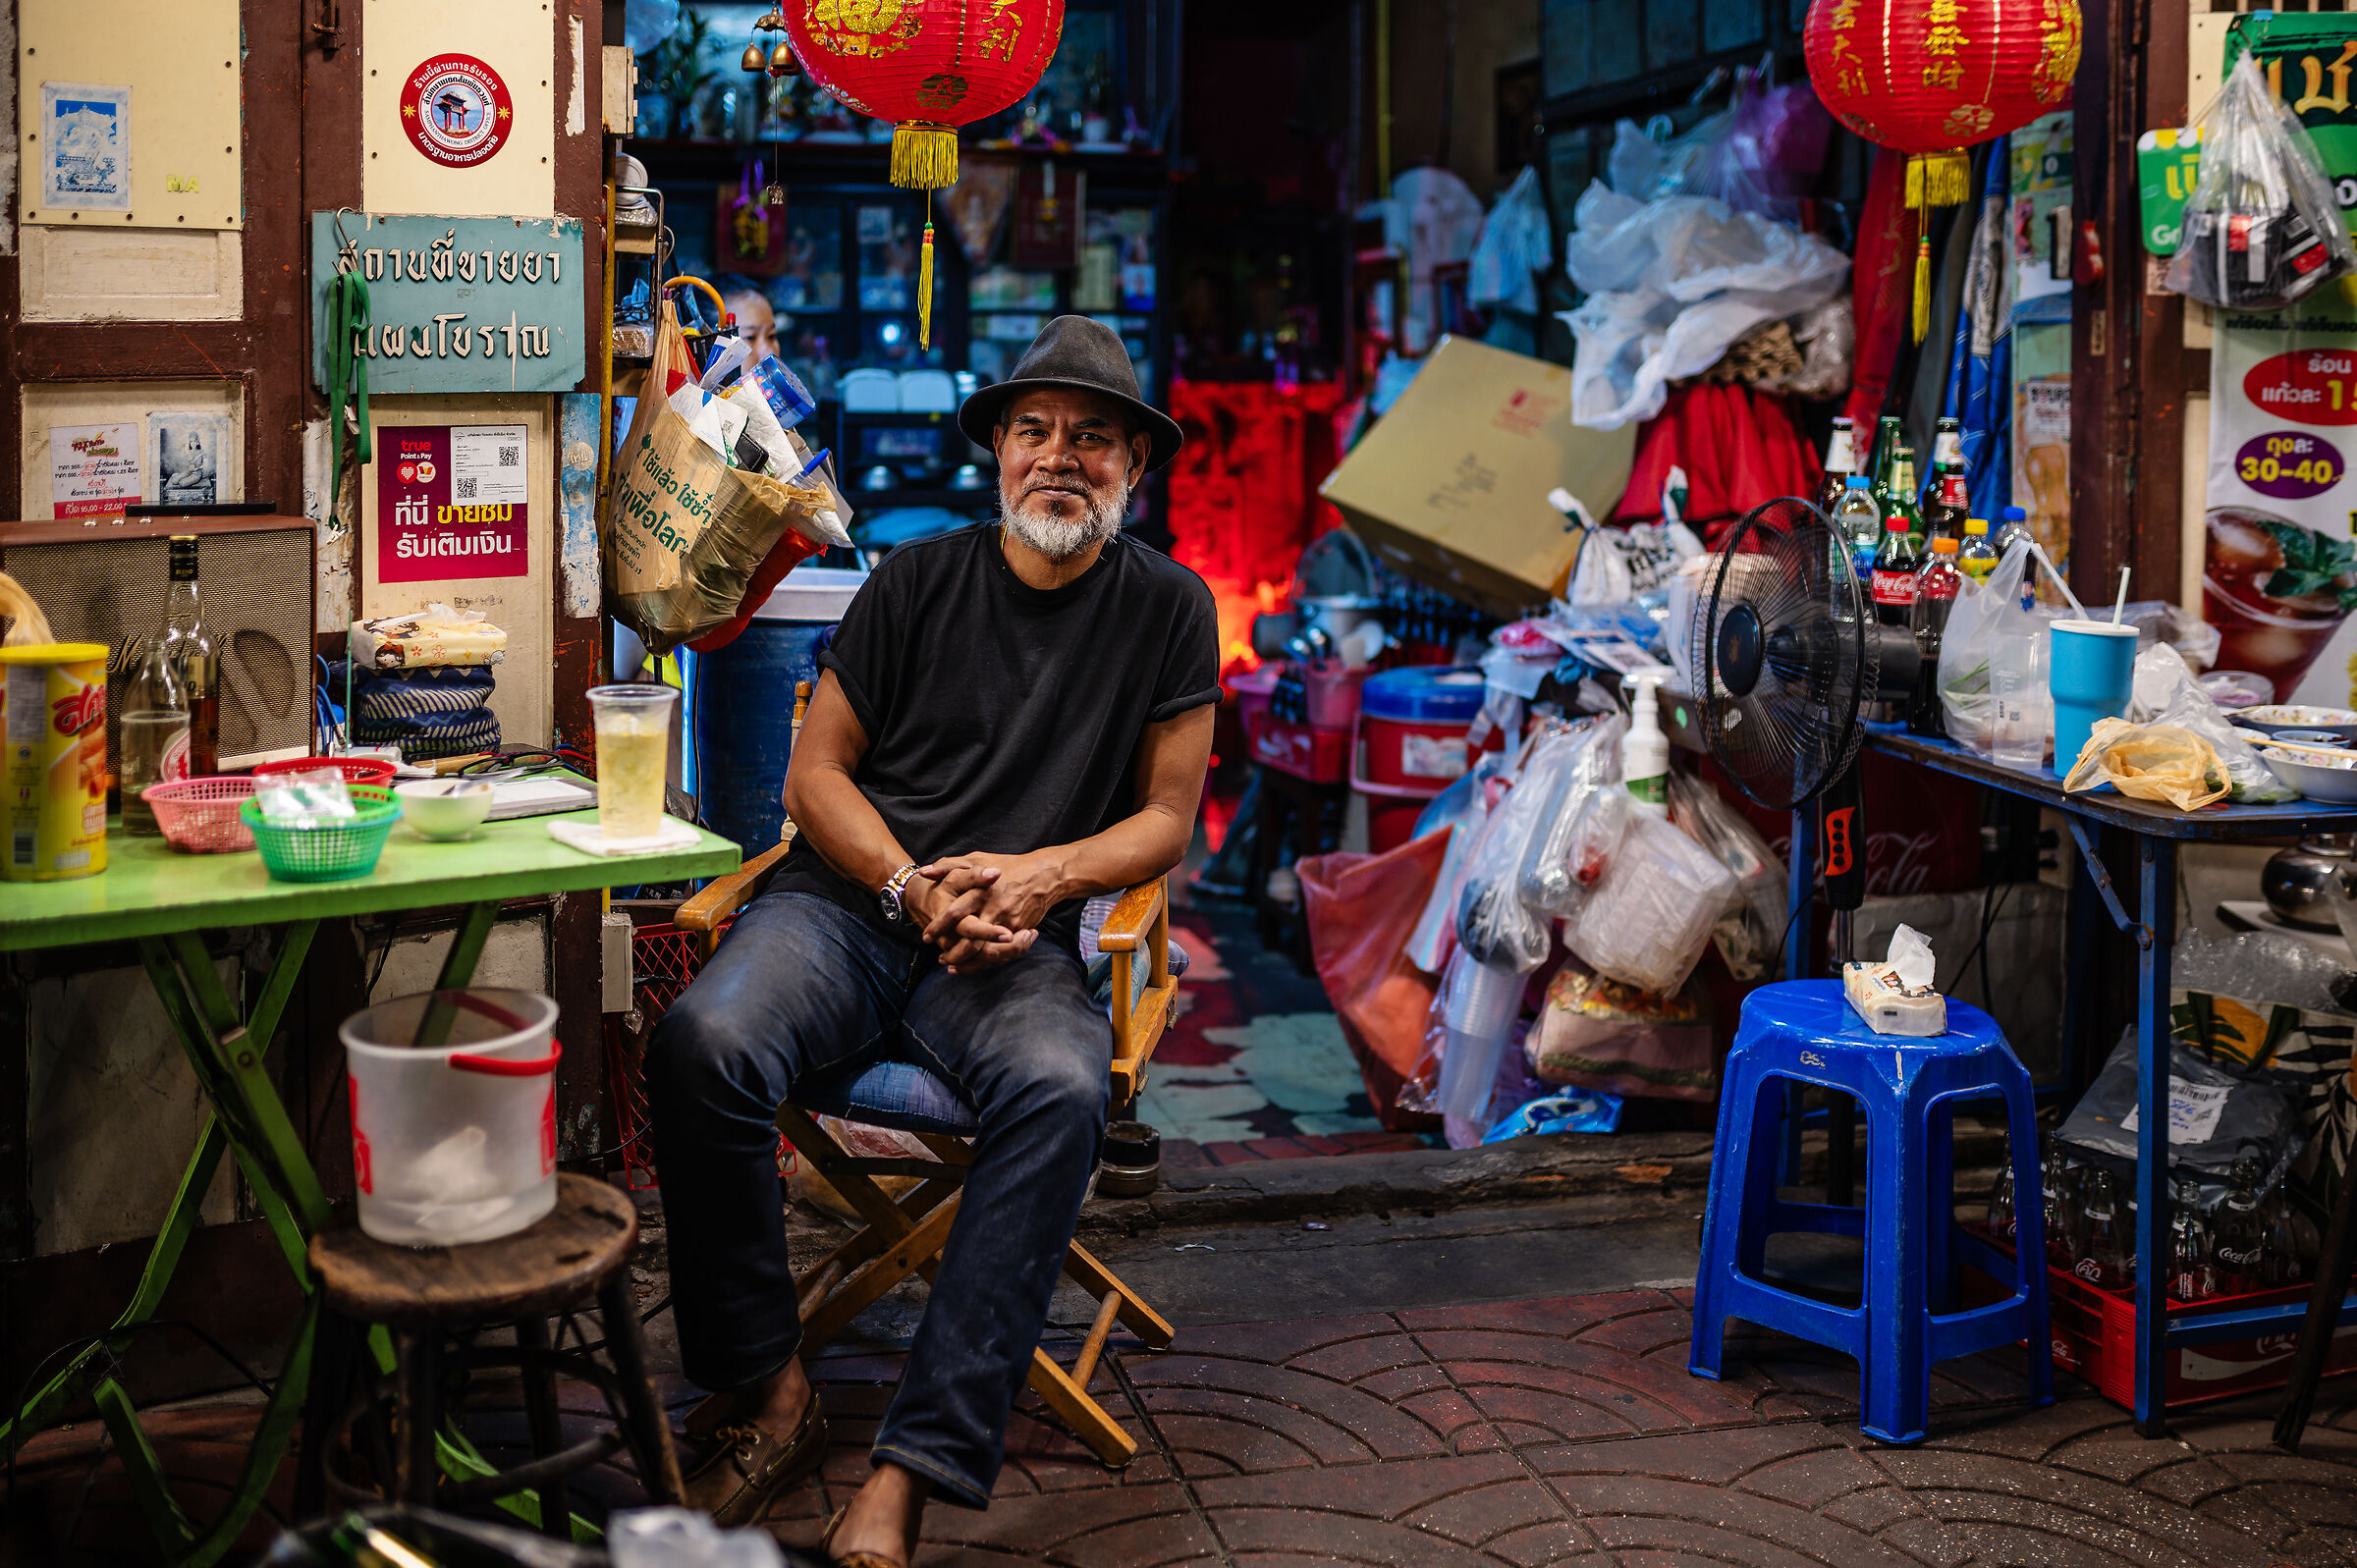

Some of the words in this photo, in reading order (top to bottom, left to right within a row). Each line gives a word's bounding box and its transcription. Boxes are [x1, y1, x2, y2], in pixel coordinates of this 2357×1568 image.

[413, 62, 498, 91] ร้านนี้ผ่านการรับรอง
[422, 76, 492, 106] สำนักงานเขตสัมพันธวงศ์
[424, 110, 464, 145] SAMPHANTHAWONG
[465, 131, 485, 145] DISTRICT
[417, 131, 499, 162] มาตรฐานอาหารปลอดภัย
[166, 174, 199, 193] MA
[338, 228, 561, 283] สถานที่ขายยา
[353, 313, 551, 359] แผนโบราณ
[2308, 352, 2352, 374] ร้อน
[2262, 381, 2322, 404] แก้วละ
[401, 440, 432, 452] true
[642, 448, 679, 495] ใช้แล้ว
[676, 483, 715, 525] ใช้ซ้ำ
[395, 494, 428, 526] ที่นี่
[396, 530, 512, 559] รับเติมเงิน
